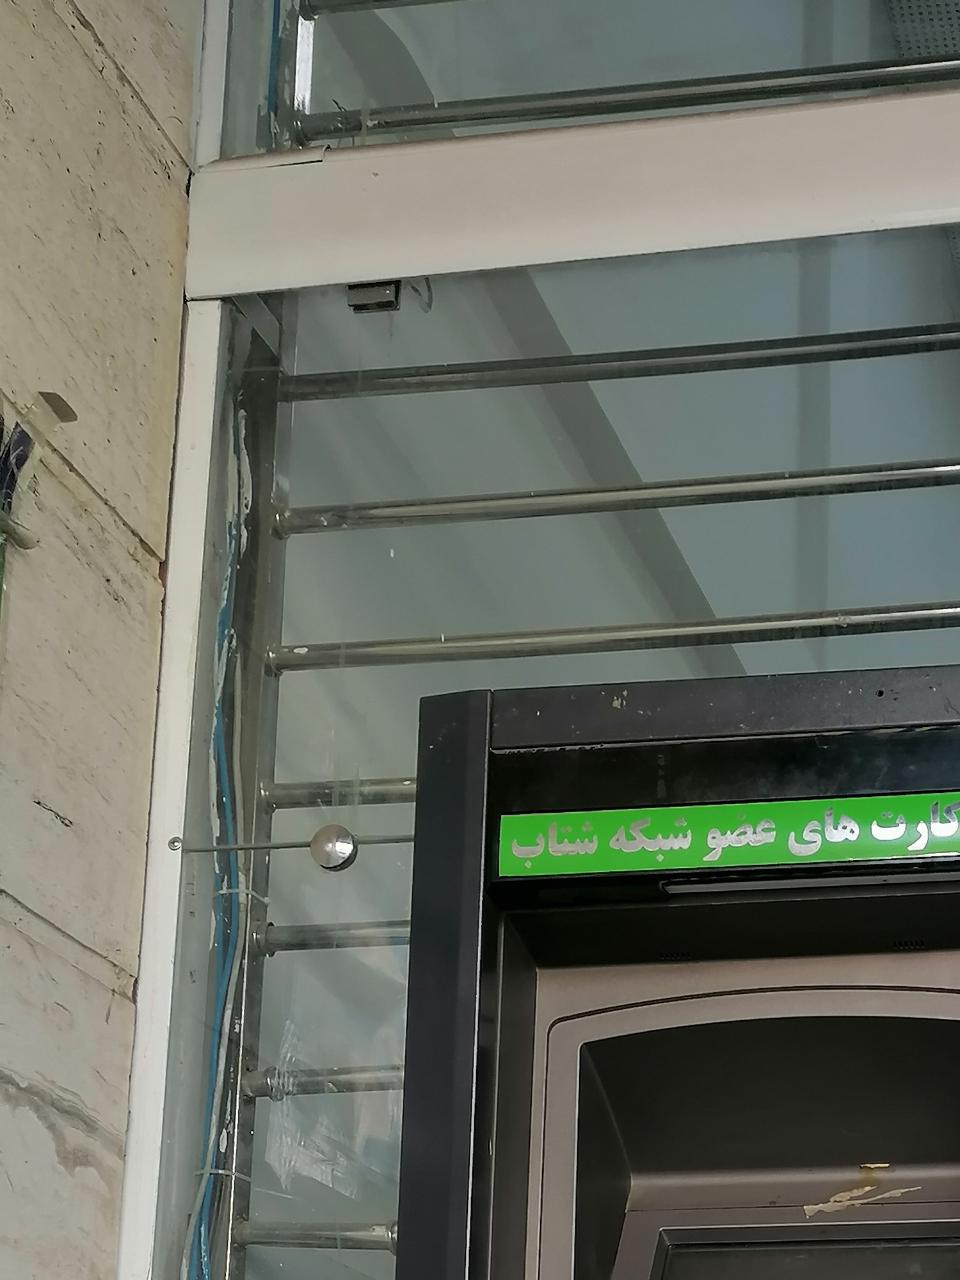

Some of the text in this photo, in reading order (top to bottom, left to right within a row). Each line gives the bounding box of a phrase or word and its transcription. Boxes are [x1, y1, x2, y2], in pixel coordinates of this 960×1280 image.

[510, 820, 599, 868] شتاب
[608, 816, 693, 862] شبکه
[702, 812, 777, 862] عضو
[787, 806, 861, 857] های
